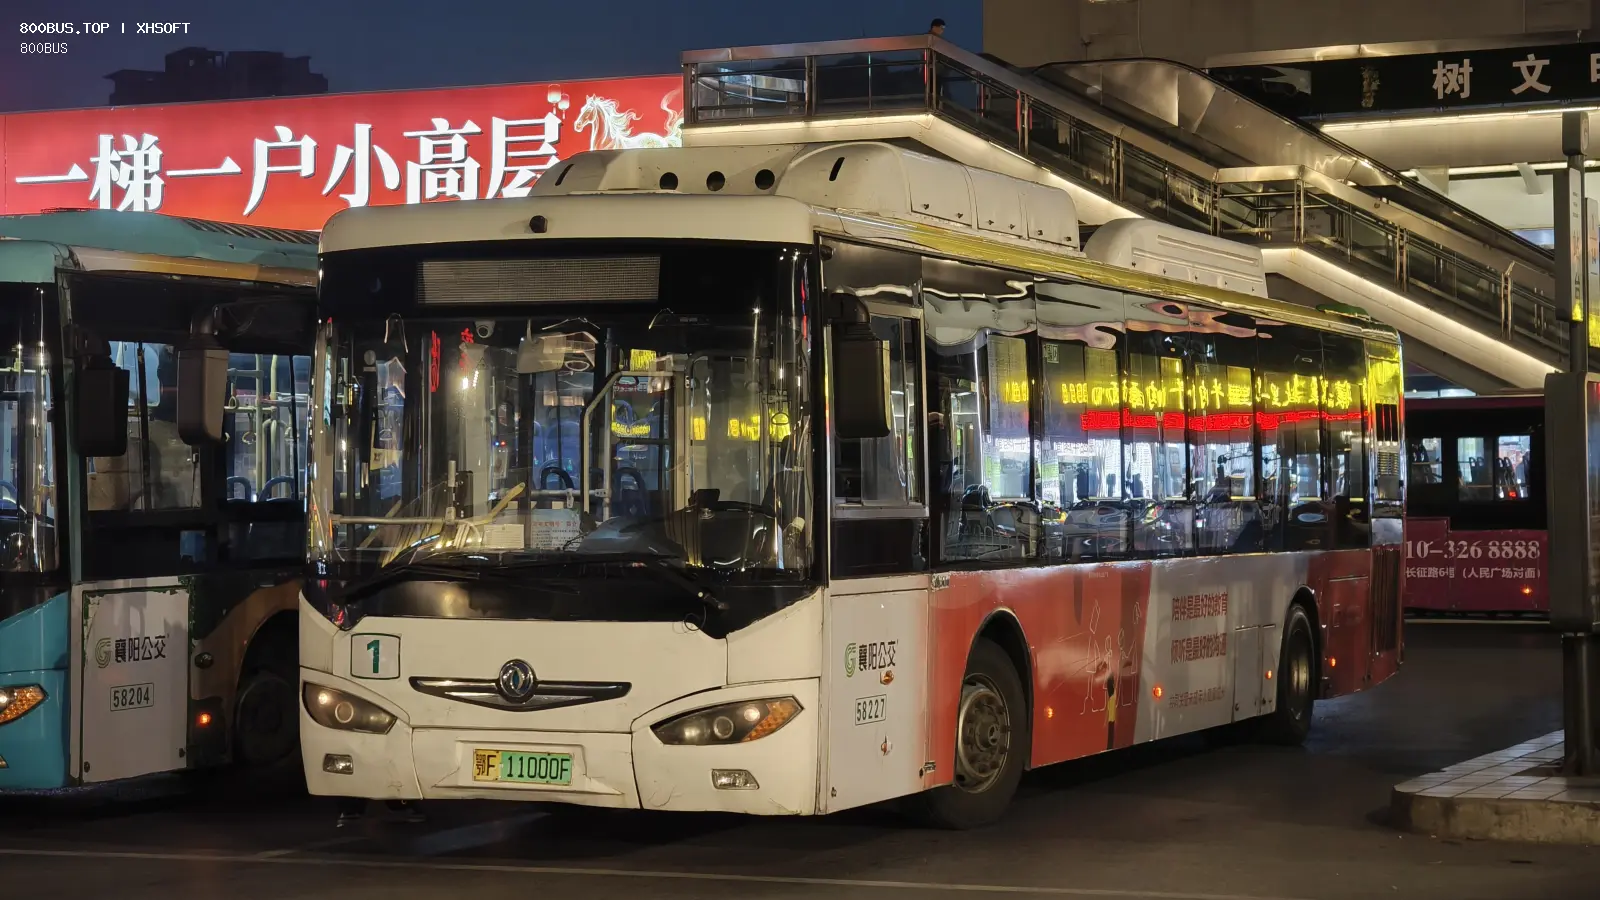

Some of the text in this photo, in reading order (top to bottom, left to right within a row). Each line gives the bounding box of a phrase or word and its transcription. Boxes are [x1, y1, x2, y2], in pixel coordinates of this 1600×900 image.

[1432, 53, 1600, 101] 树文
[15, 112, 562, 216] 一梯一户小高层
[1488, 540, 1541, 559] 8888
[114, 635, 166, 663] 襄阳公交
[367, 640, 380, 673] 1
[858, 640, 896, 672] 襄阳公交
[113, 686, 150, 708] 58204
[857, 699, 885, 722] 58227
[507, 755, 571, 780] 11000F
